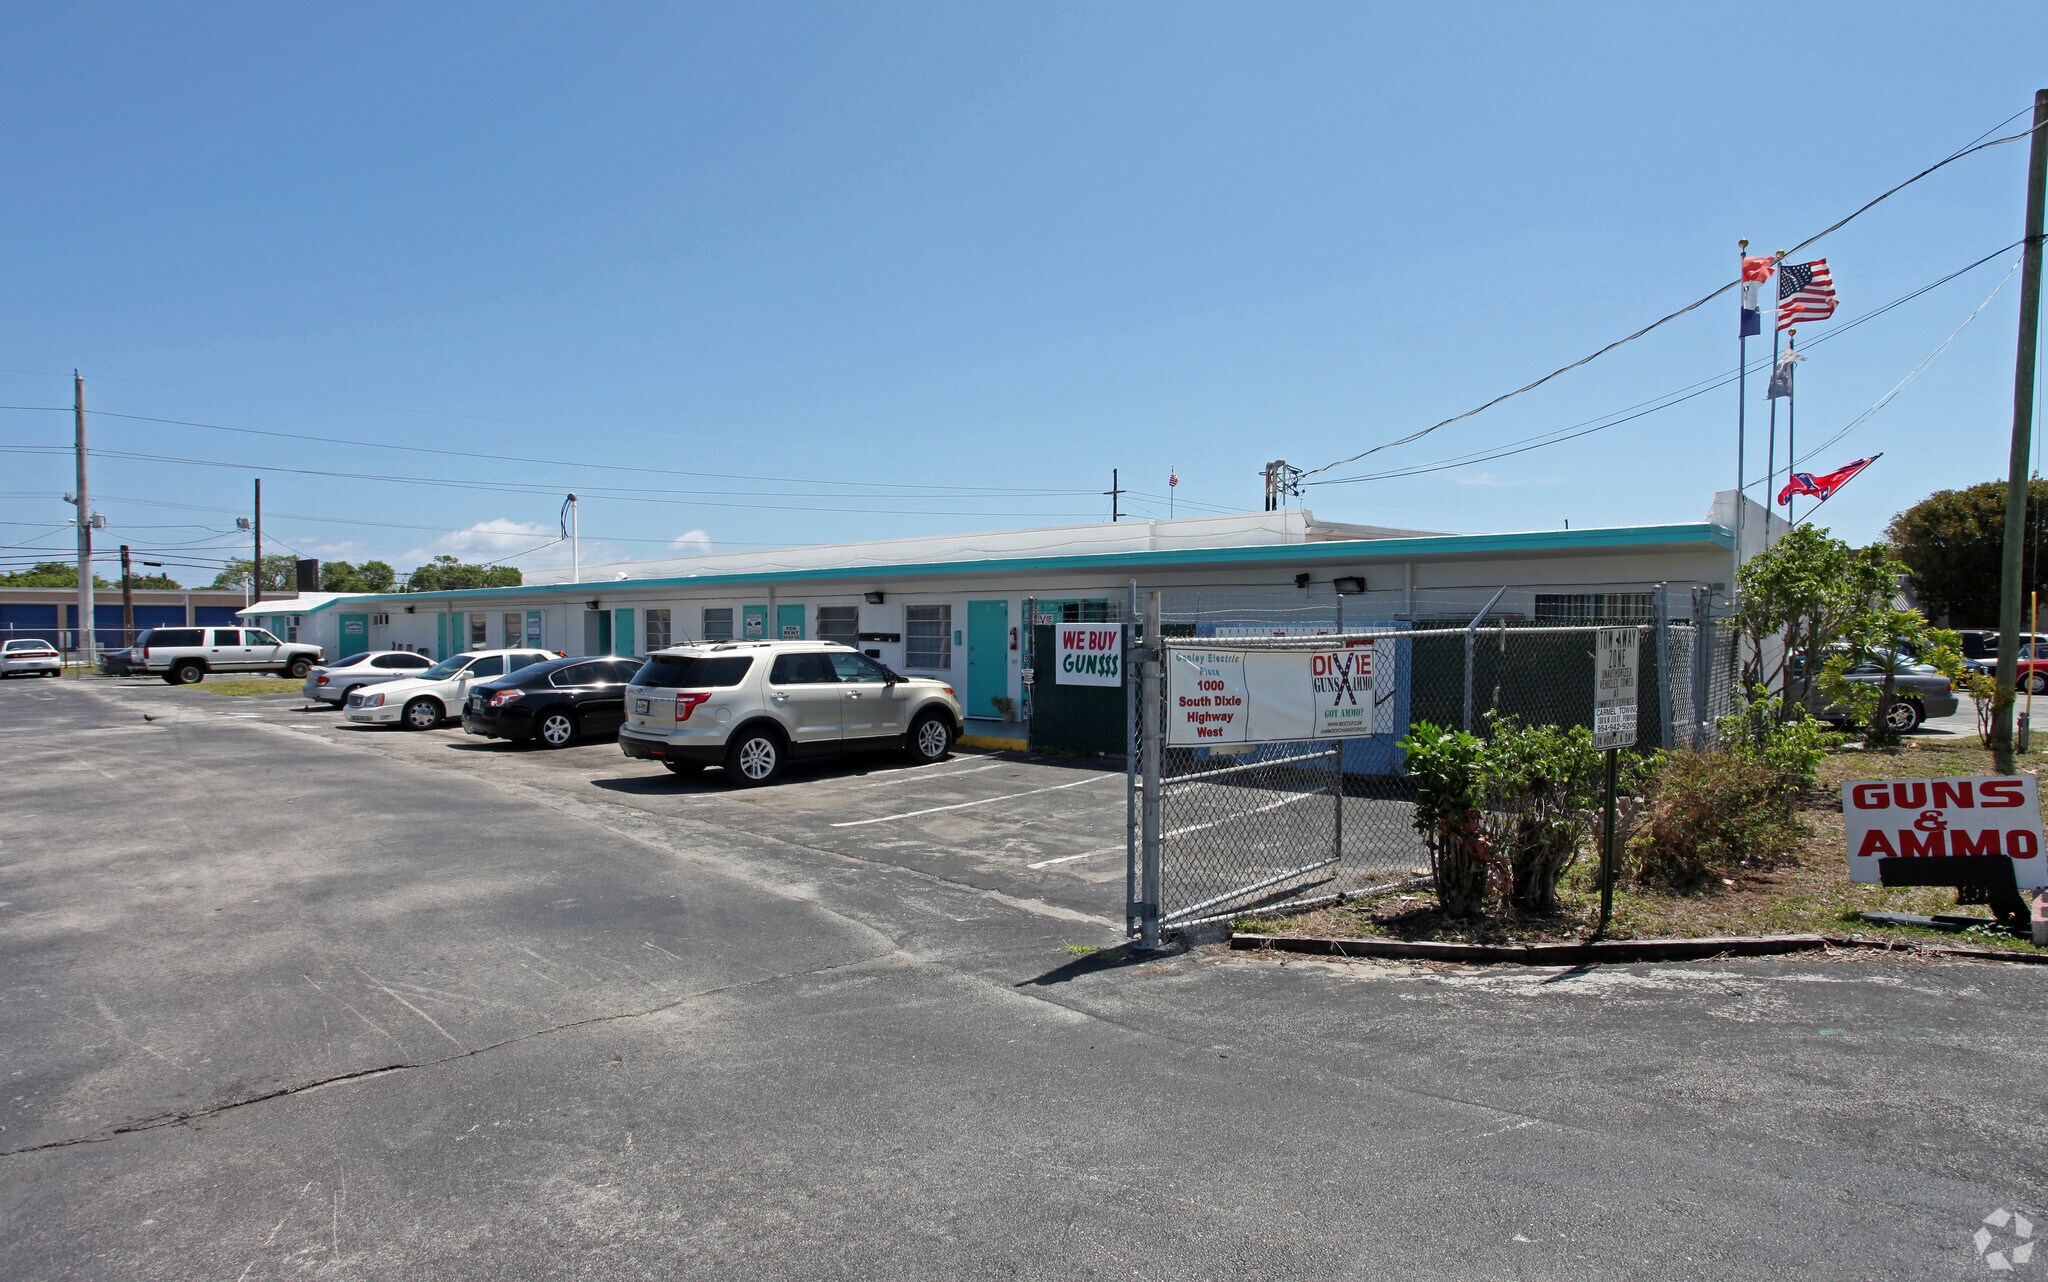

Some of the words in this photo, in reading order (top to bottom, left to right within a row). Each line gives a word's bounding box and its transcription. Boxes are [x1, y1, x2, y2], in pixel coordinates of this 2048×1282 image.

[1063, 631, 1086, 650] WE
[1089, 631, 1117, 651] BUY
[1600, 631, 1613, 649] TOW
[1617, 629, 1636, 648] AWAY
[1208, 653, 1240, 663] Electric
[1609, 649, 1626, 668] ZONE
[1063, 653, 1119, 677] GUN$$$
[1602, 668, 1632, 679] UNAUTHORIZED
[1197, 680, 1224, 691] 1000
[1314, 677, 1339, 693] GUNS
[1352, 676, 1373, 691] AMMO
[1600, 679, 1618, 689] VEHICLES
[1621, 677, 1633, 687] TOWED
[1613, 689, 1619, 698] AT
[1179, 696, 1211, 707] South
[1214, 695, 1242, 706] Dixie
[1187, 712, 1234, 724] Highway
[1324, 709, 1338, 718] GOT
[1340, 708, 1364, 717] AMMO?
[1596, 708, 1616, 716] CARMEL
[1197, 726, 1223, 737] West
[1625, 733, 1633, 743] DAY
[1852, 780, 2025, 809] GUNS
[1913, 809, 1948, 832] &
[1857, 829, 2038, 860] AMMO
